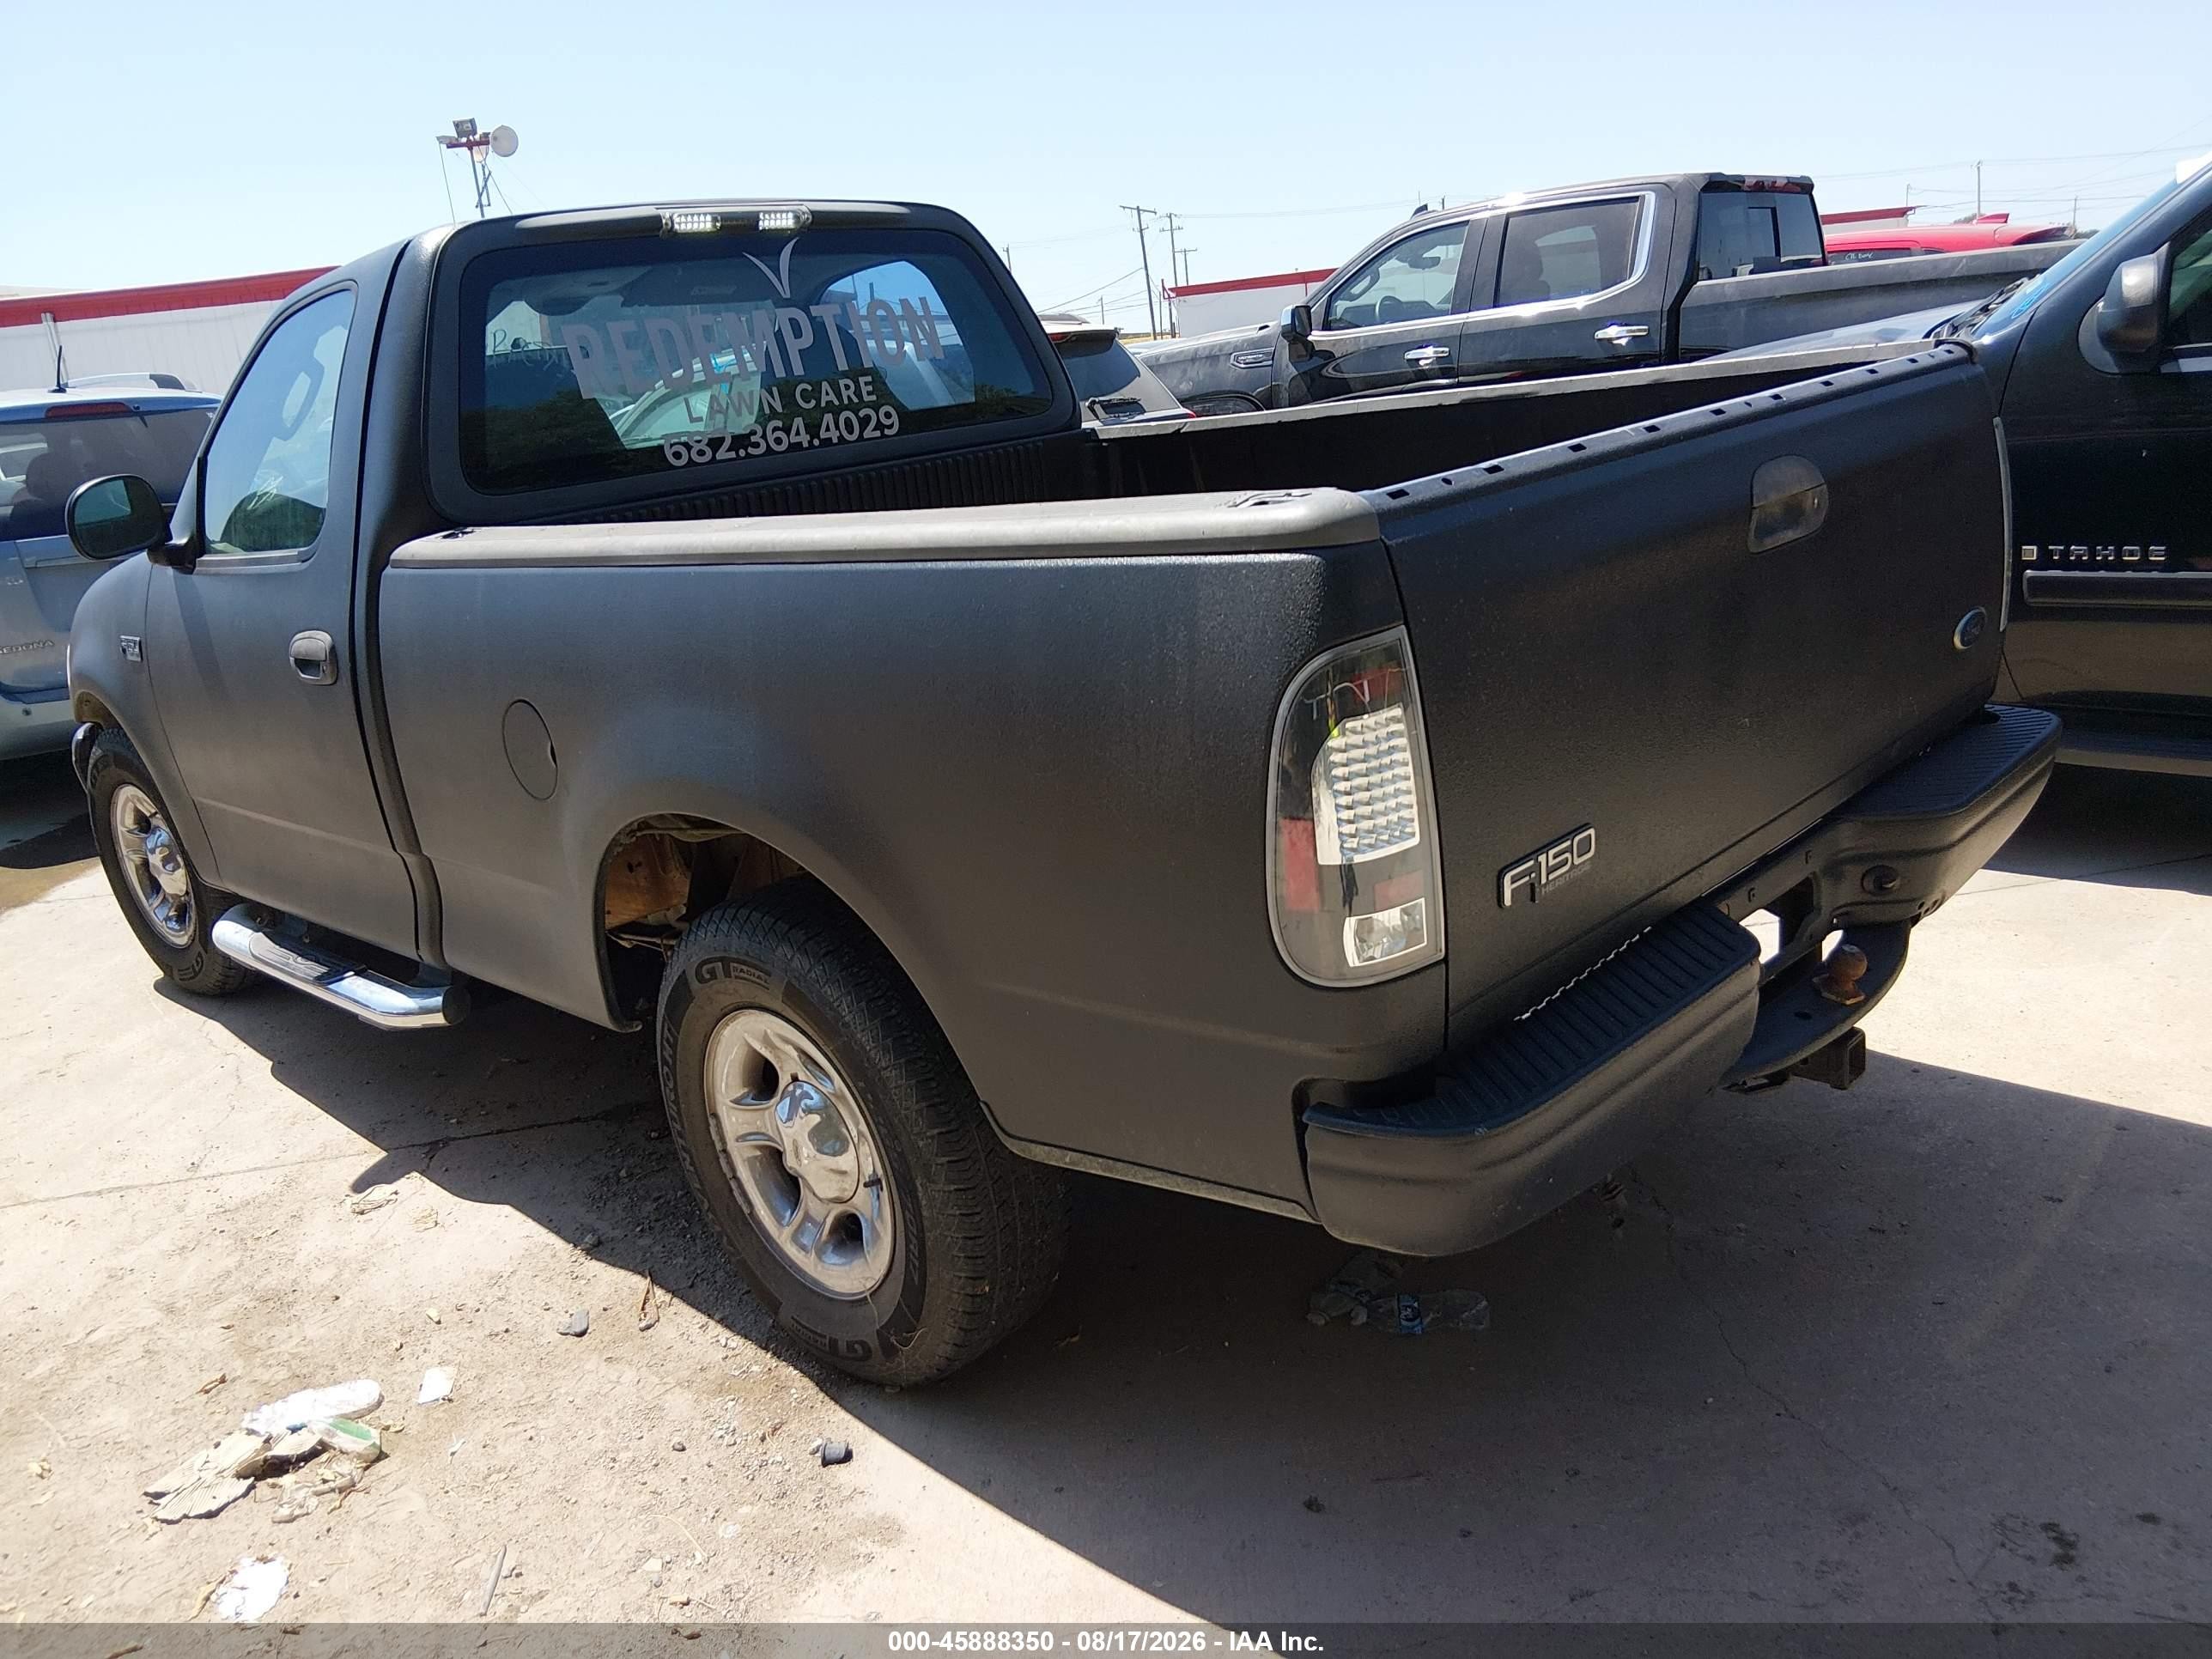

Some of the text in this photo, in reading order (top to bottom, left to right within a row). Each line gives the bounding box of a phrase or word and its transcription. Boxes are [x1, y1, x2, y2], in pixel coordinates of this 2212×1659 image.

[561, 296, 944, 399] REDEMPTION
[684, 376, 878, 423] LAWN CARE
[664, 405, 900, 467] 682.364.4029
[2048, 545, 2166, 561] TAHOE
[1541, 860, 1591, 895] HERITAGE
[695, 956, 770, 985] GT RADIAL
